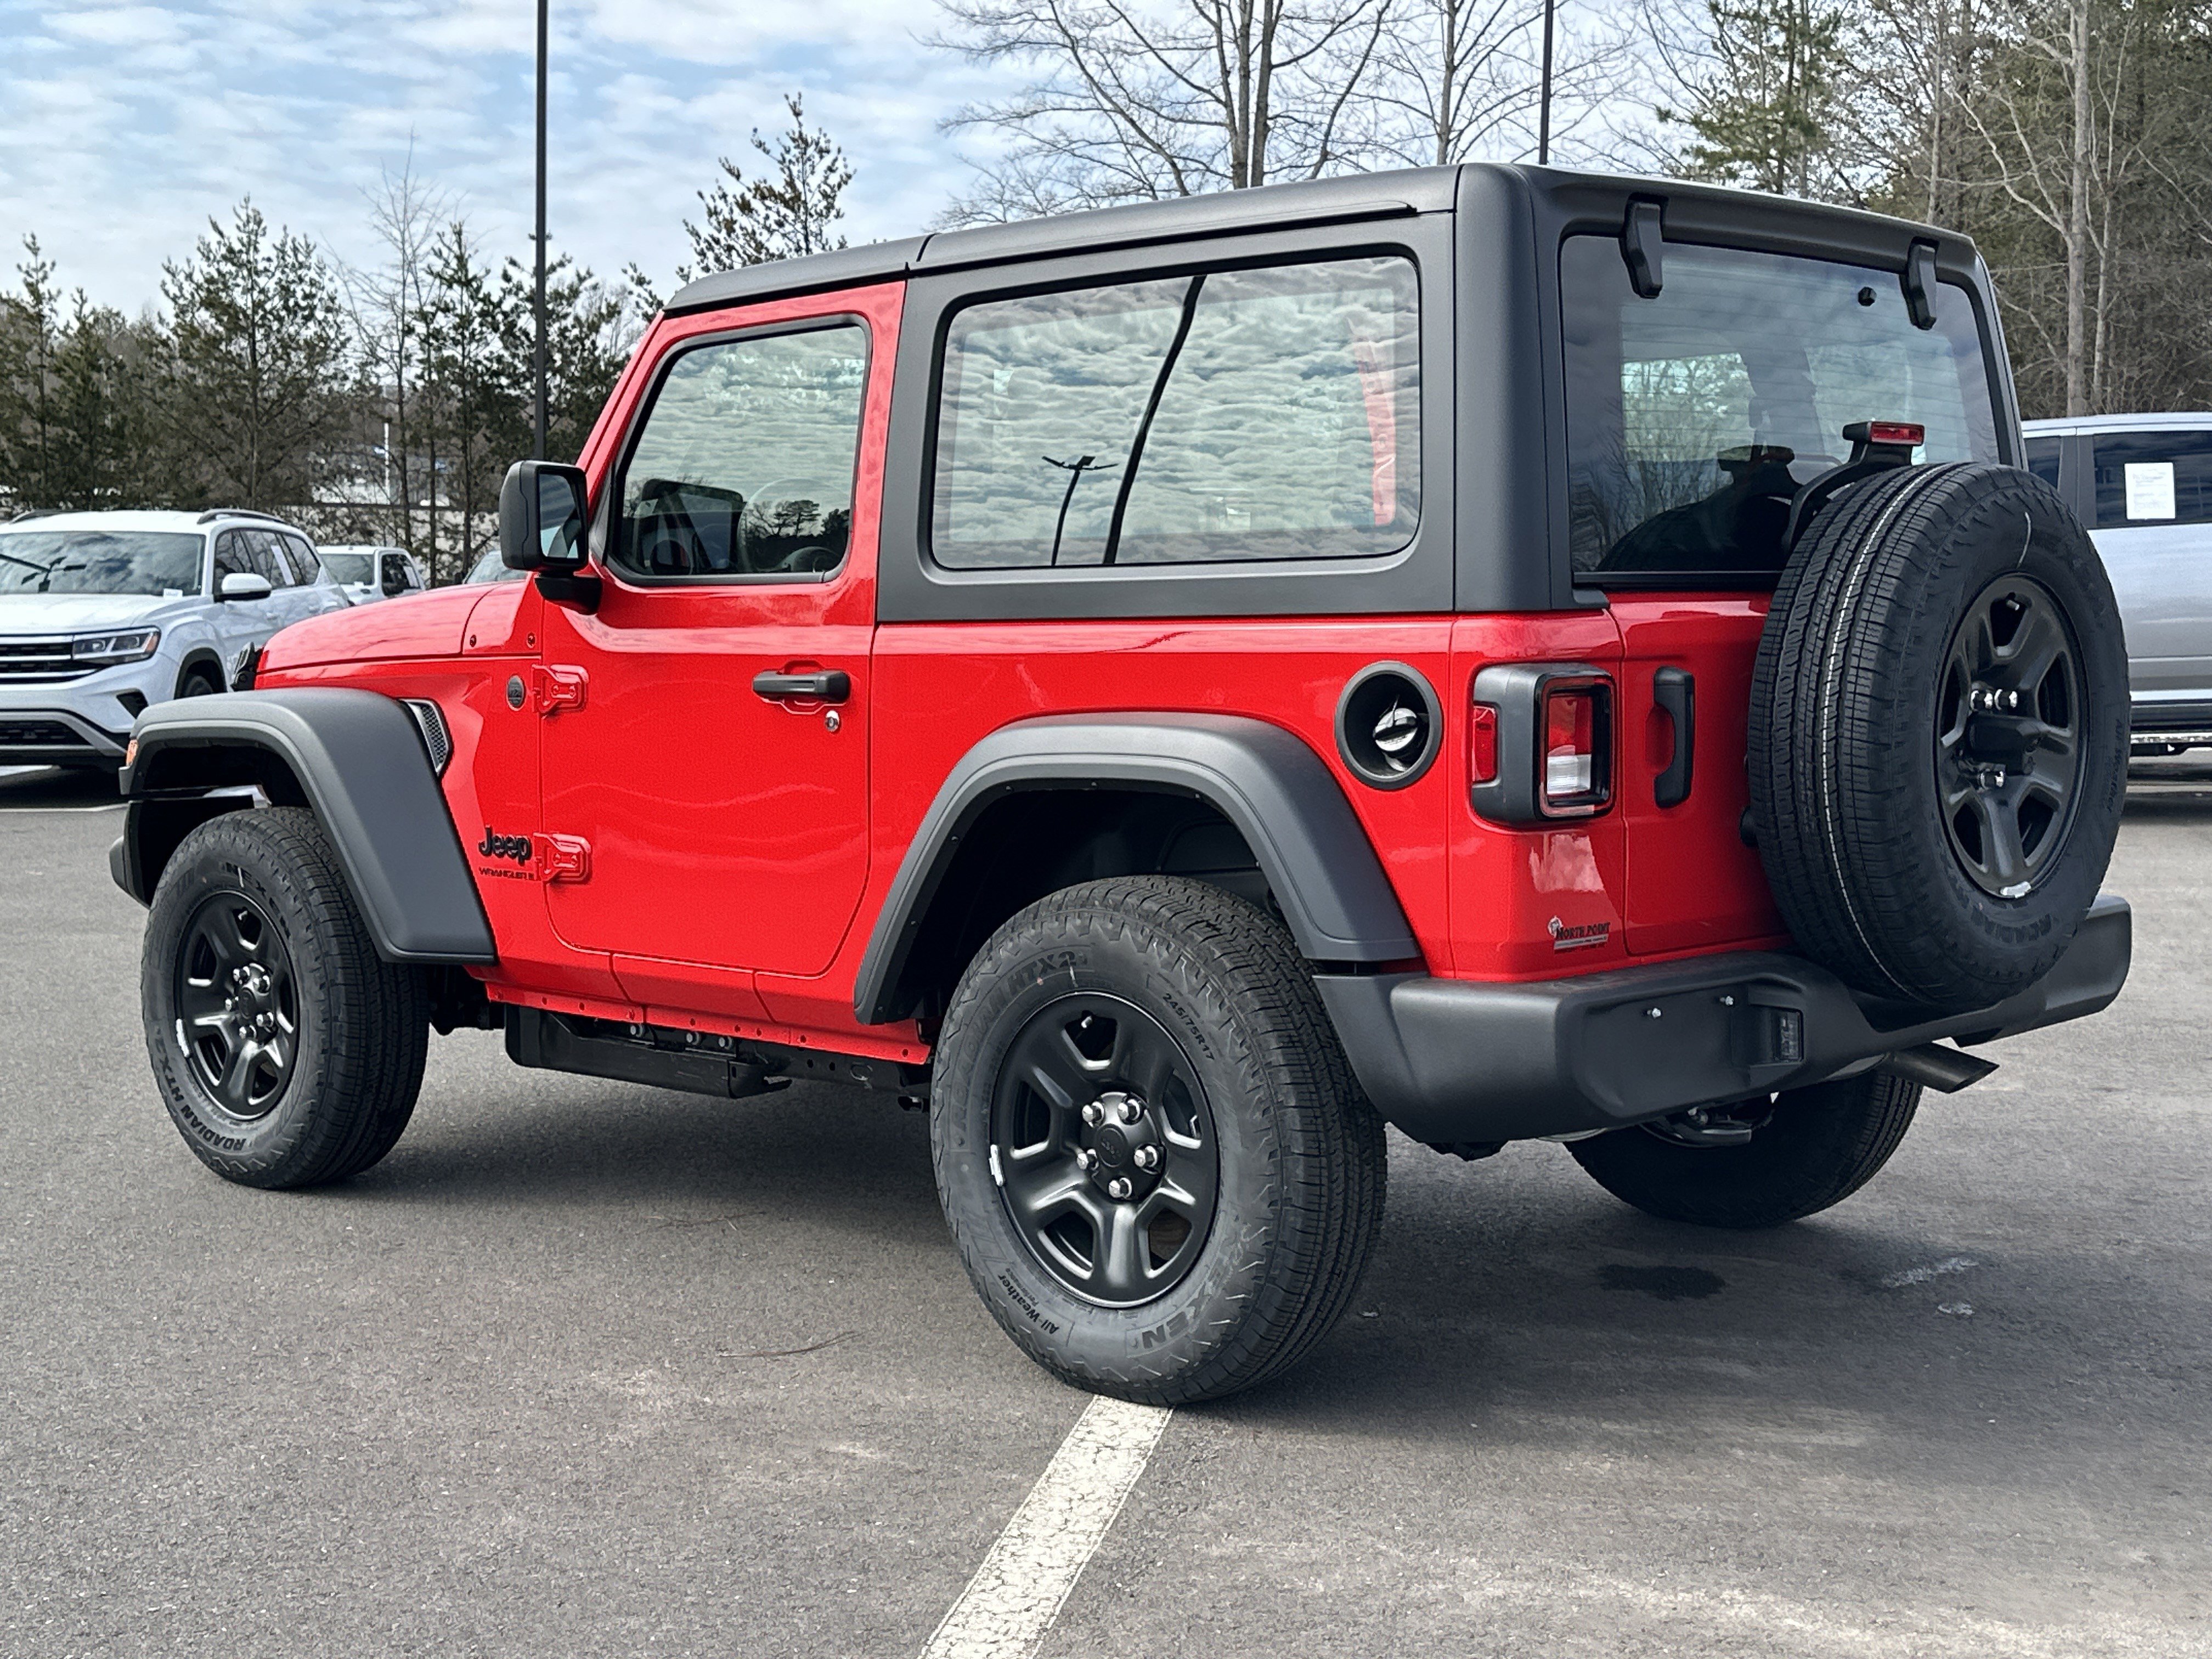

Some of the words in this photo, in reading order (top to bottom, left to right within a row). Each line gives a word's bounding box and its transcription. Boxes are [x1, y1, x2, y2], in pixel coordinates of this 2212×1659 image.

[478, 824, 532, 866] Jeep
[1162, 992, 1215, 1060] 245/75R17
[180, 1104, 247, 1151] ROADIAN
[997, 1274, 1060, 1335] All-Weather
